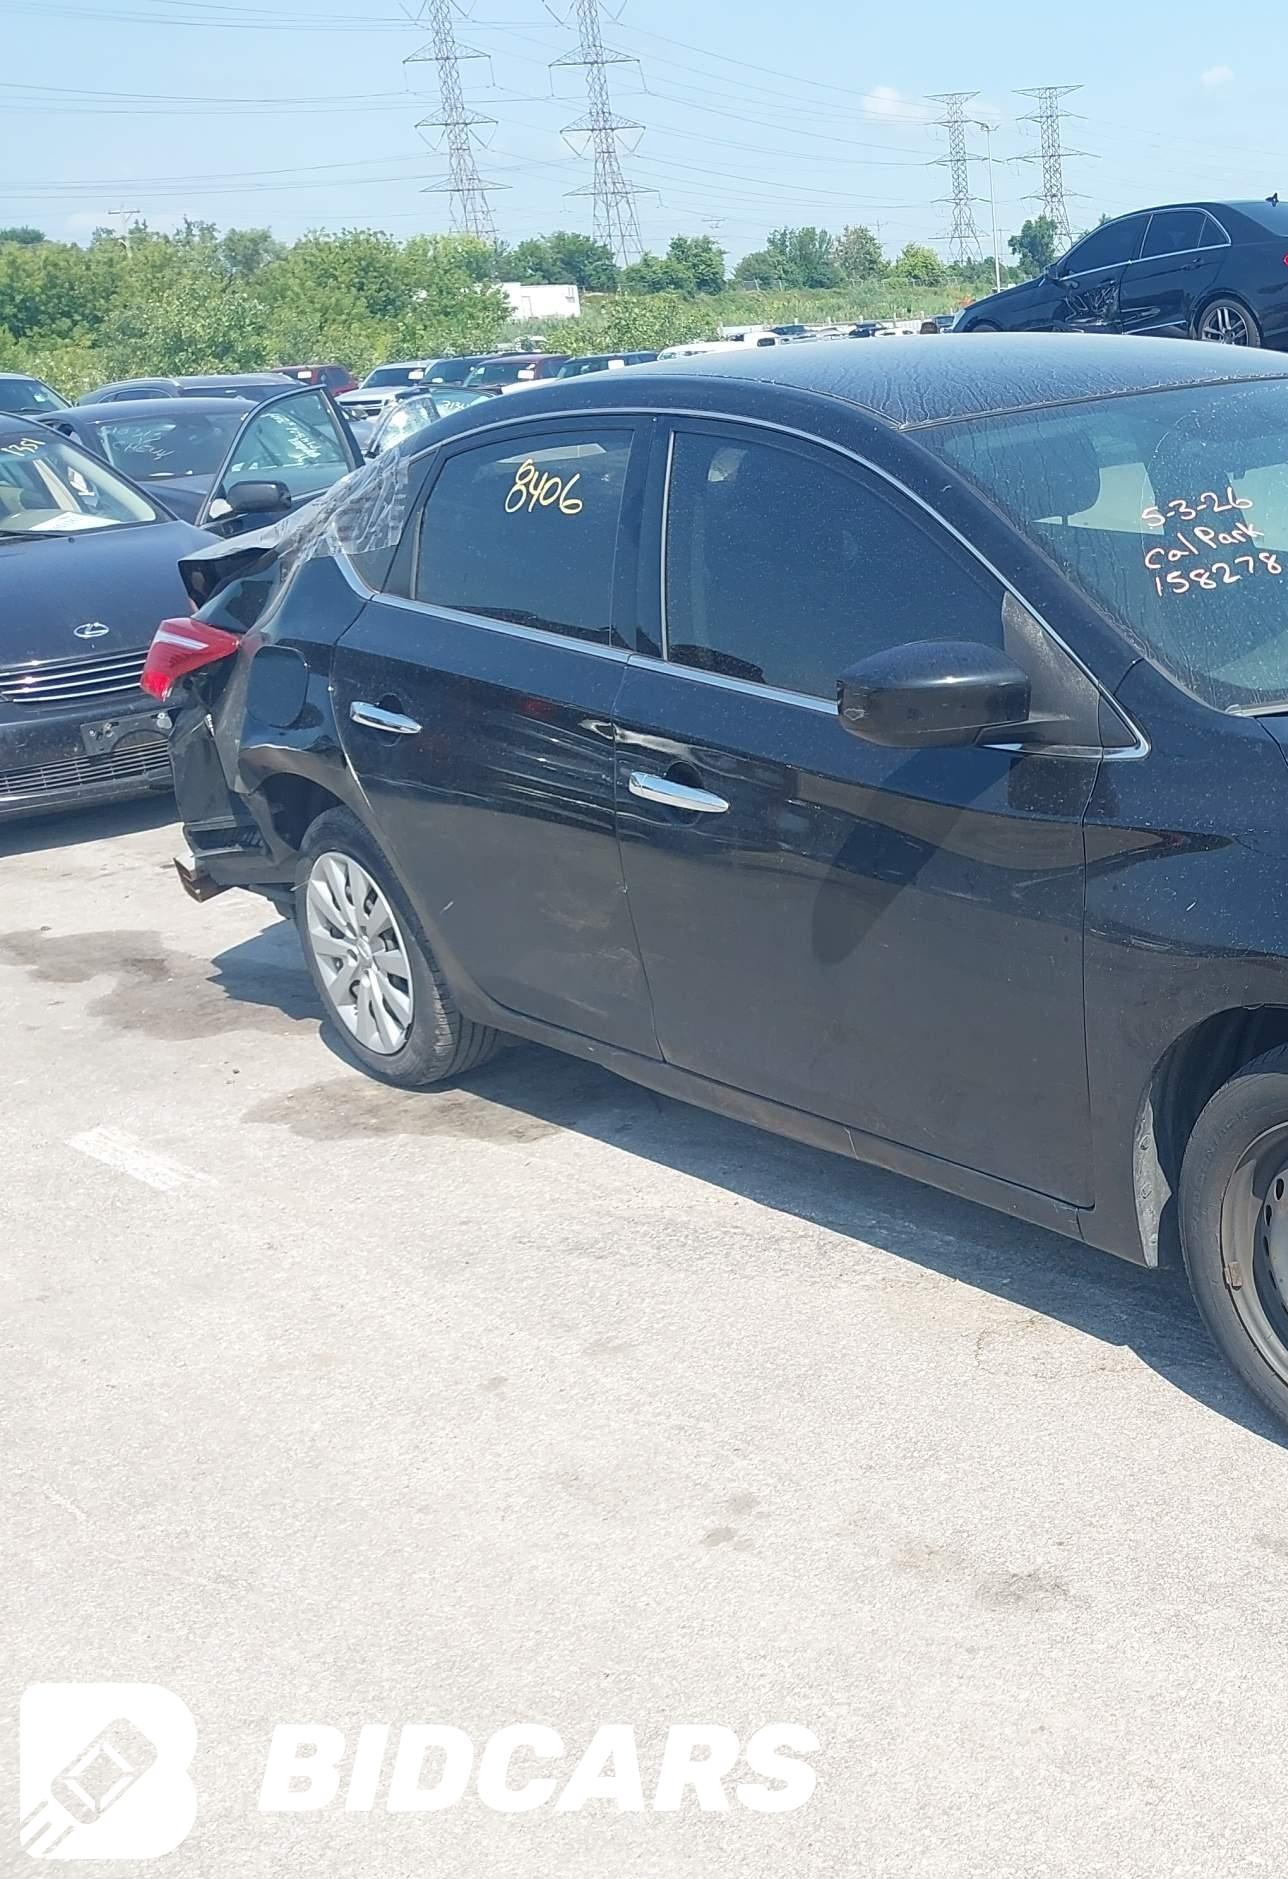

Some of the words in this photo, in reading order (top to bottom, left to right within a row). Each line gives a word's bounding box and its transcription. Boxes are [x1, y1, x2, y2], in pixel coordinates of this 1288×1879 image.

[504, 458, 583, 515] 8406
[1141, 486, 1254, 527] 5-3-26
[1144, 532, 1199, 580] Cal
[1193, 522, 1265, 549] Park
[1155, 552, 1283, 597] 158278
